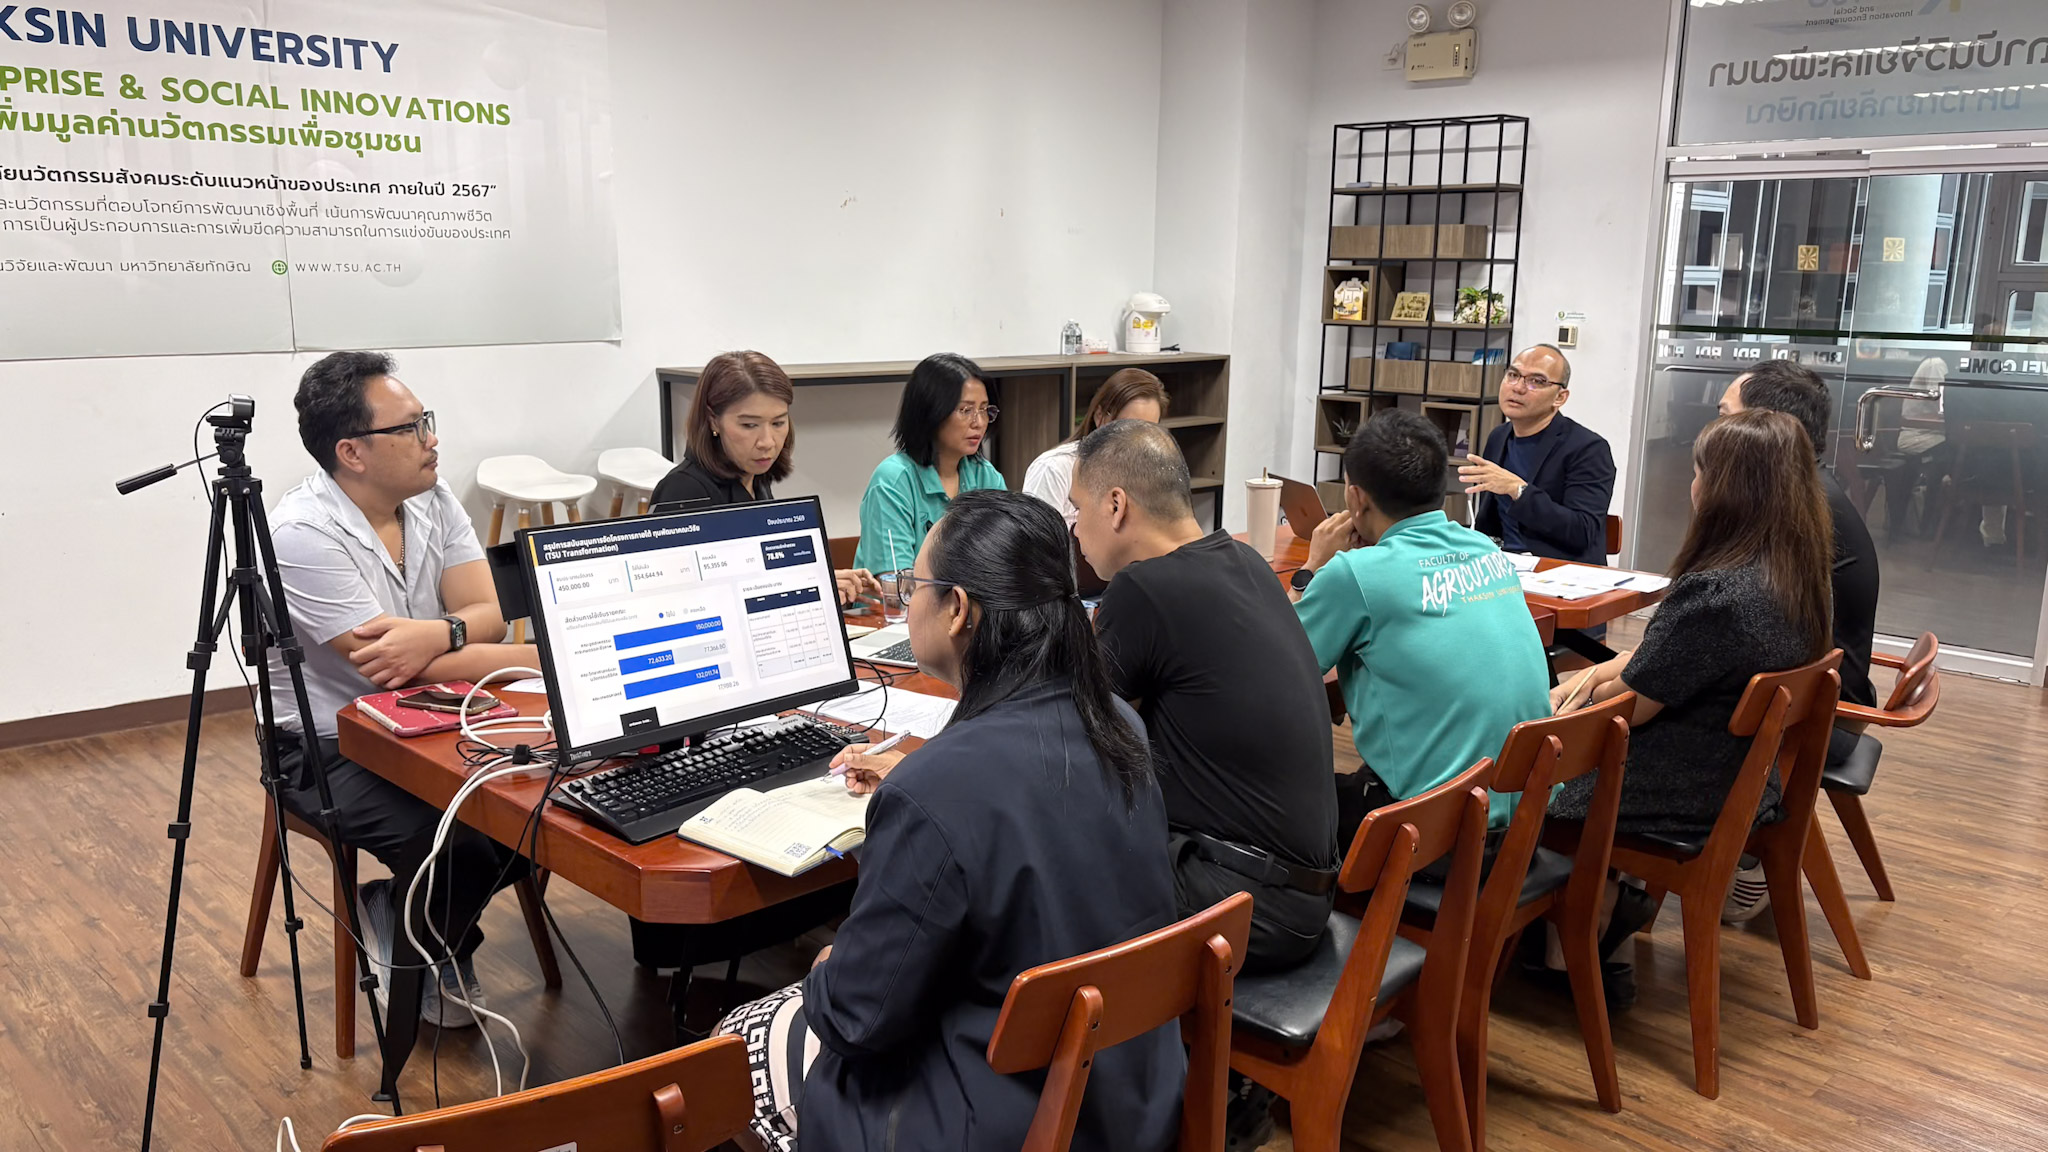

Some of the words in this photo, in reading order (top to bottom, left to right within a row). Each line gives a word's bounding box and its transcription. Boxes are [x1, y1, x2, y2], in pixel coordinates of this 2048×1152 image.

[127, 16, 400, 73] UNIVERSITY
[0, 65, 105, 97] PRISE
[119, 74, 147, 100] &
[161, 77, 290, 111] SOCIAL
[301, 88, 511, 126] INNOVATIONS
[0, 164, 381, 194] ยนวัตกรรมสังคมระดับแนวหน้าของประเทศ
[388, 181, 446, 197] ภายในปี
[120, 259, 251, 273] มหาวิทยาลัยทักษิณ
[295, 263, 402, 273] WWW.TSU.AC.TH
[545, 551, 561, 562] (TSU
[563, 543, 619, 559] Transformation)
[1418, 552, 1456, 569] FACULTY
[1459, 552, 1470, 561] OF
